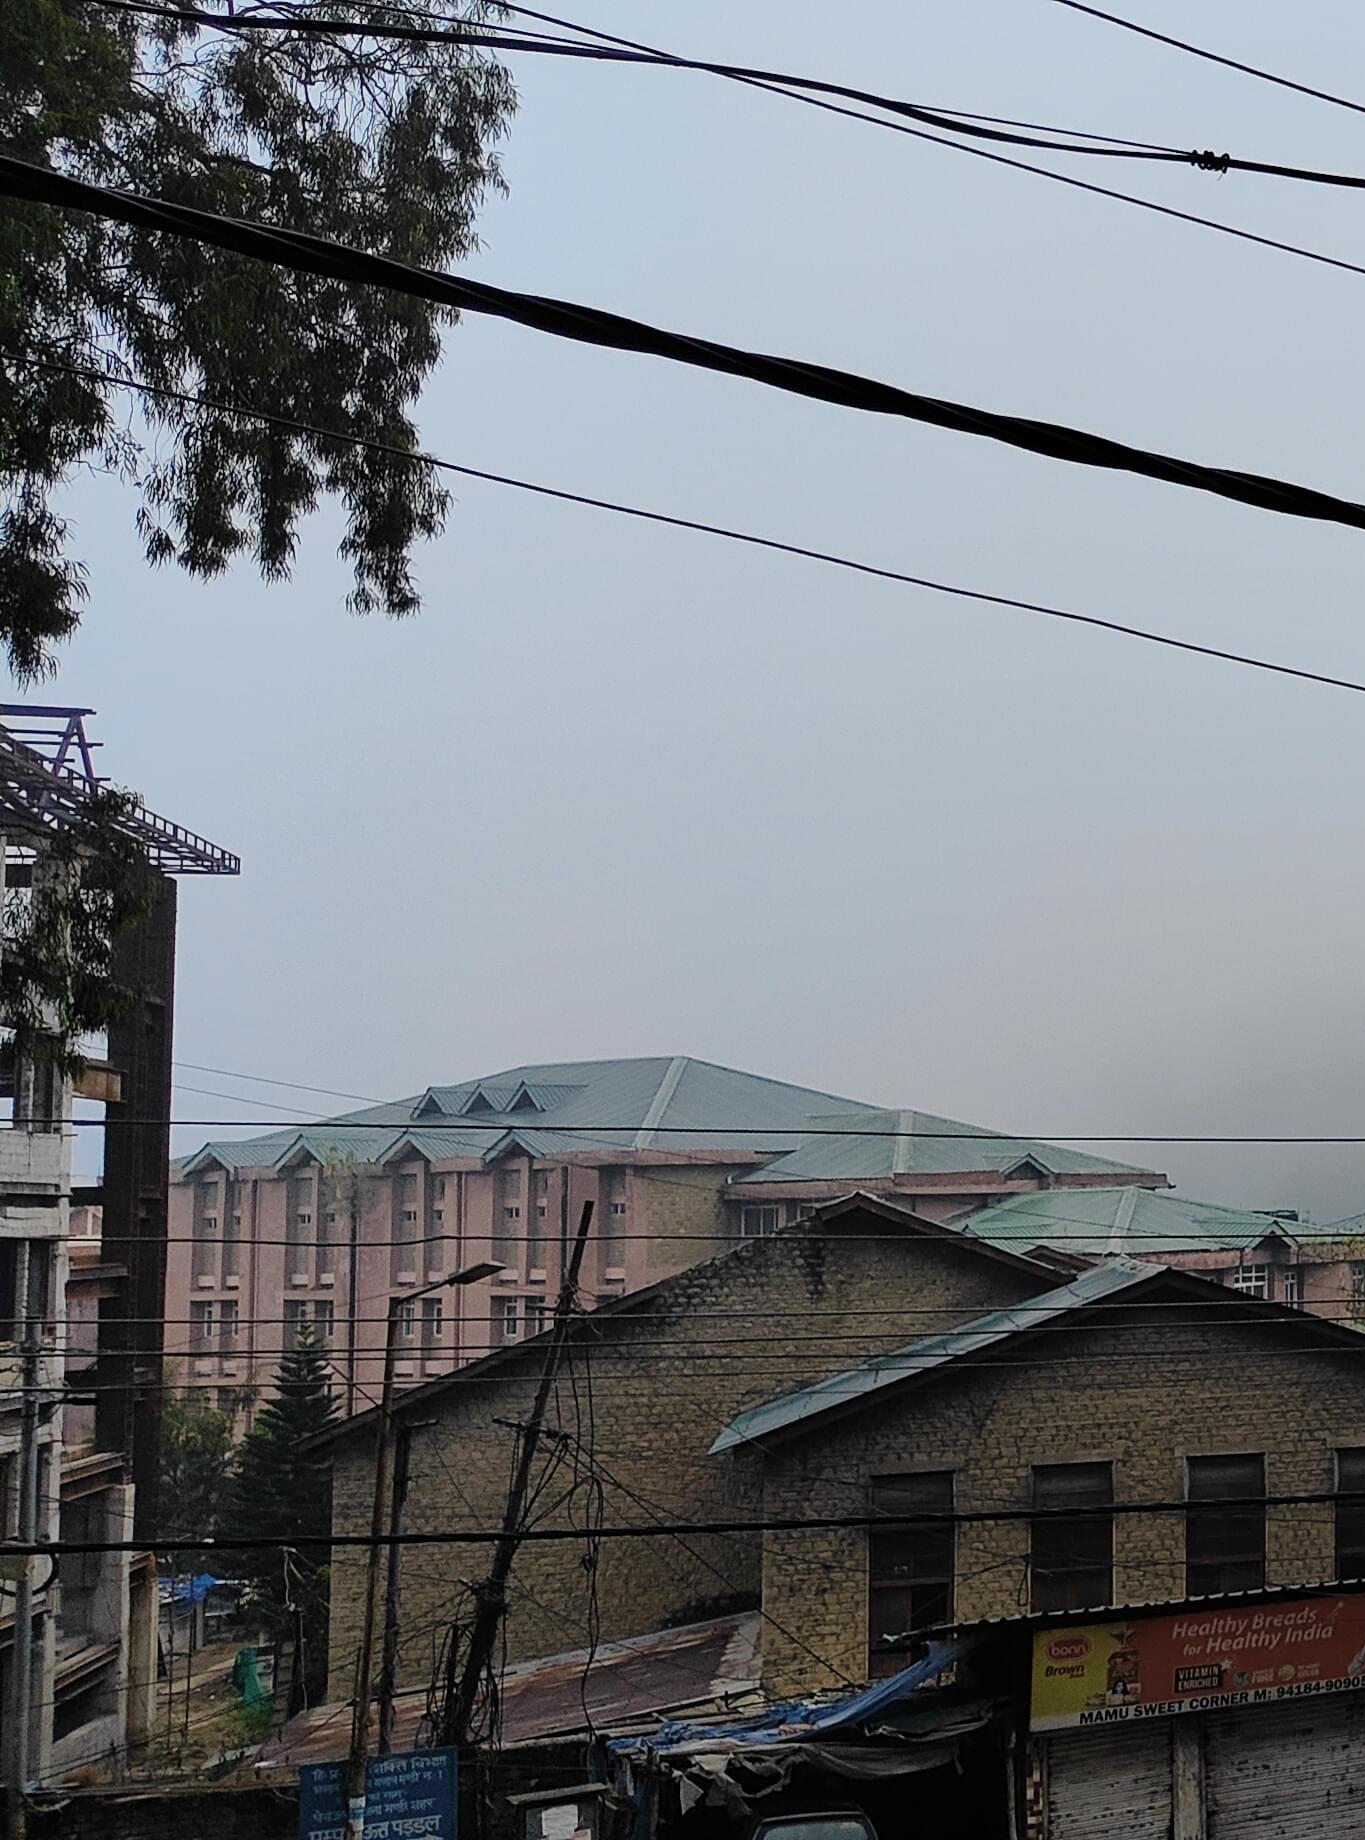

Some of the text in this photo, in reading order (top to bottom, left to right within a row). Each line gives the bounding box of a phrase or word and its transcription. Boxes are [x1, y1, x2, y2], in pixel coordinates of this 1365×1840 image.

[1172, 1607, 1317, 1640] Healthy Breads
[1182, 1622, 1333, 1657] for Healthy India
[1051, 1642, 1086, 1657] bonn
[1045, 1664, 1085, 1677] Brown
[1178, 1666, 1219, 1680] VITAMIN
[1178, 1676, 1219, 1691] ENRICHED
[1079, 1706, 1130, 1724] MAMU
[1134, 1700, 1185, 1717] SWEET
[1190, 1691, 1249, 1709] CORNER
[1253, 1689, 1272, 1702] M:
